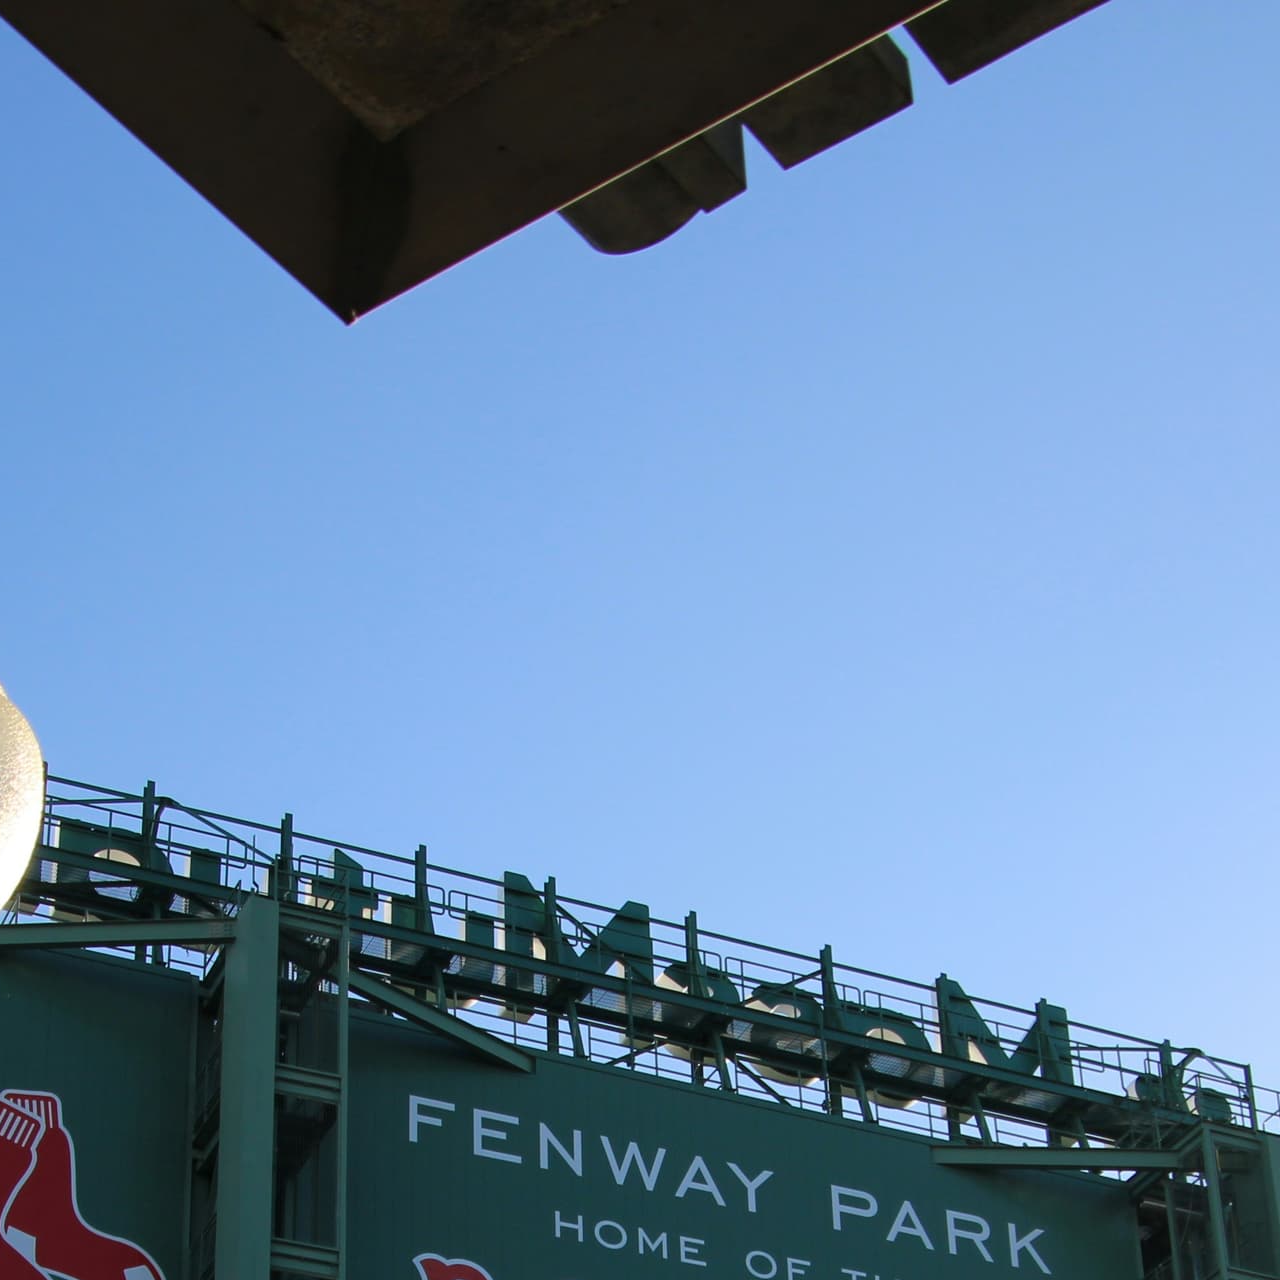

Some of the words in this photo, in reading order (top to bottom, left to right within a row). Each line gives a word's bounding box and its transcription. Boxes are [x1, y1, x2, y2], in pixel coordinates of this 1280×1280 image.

[408, 1094, 774, 1213] FENWAY
[831, 1184, 1052, 1275] PARK
[553, 1210, 707, 1267] HOME
